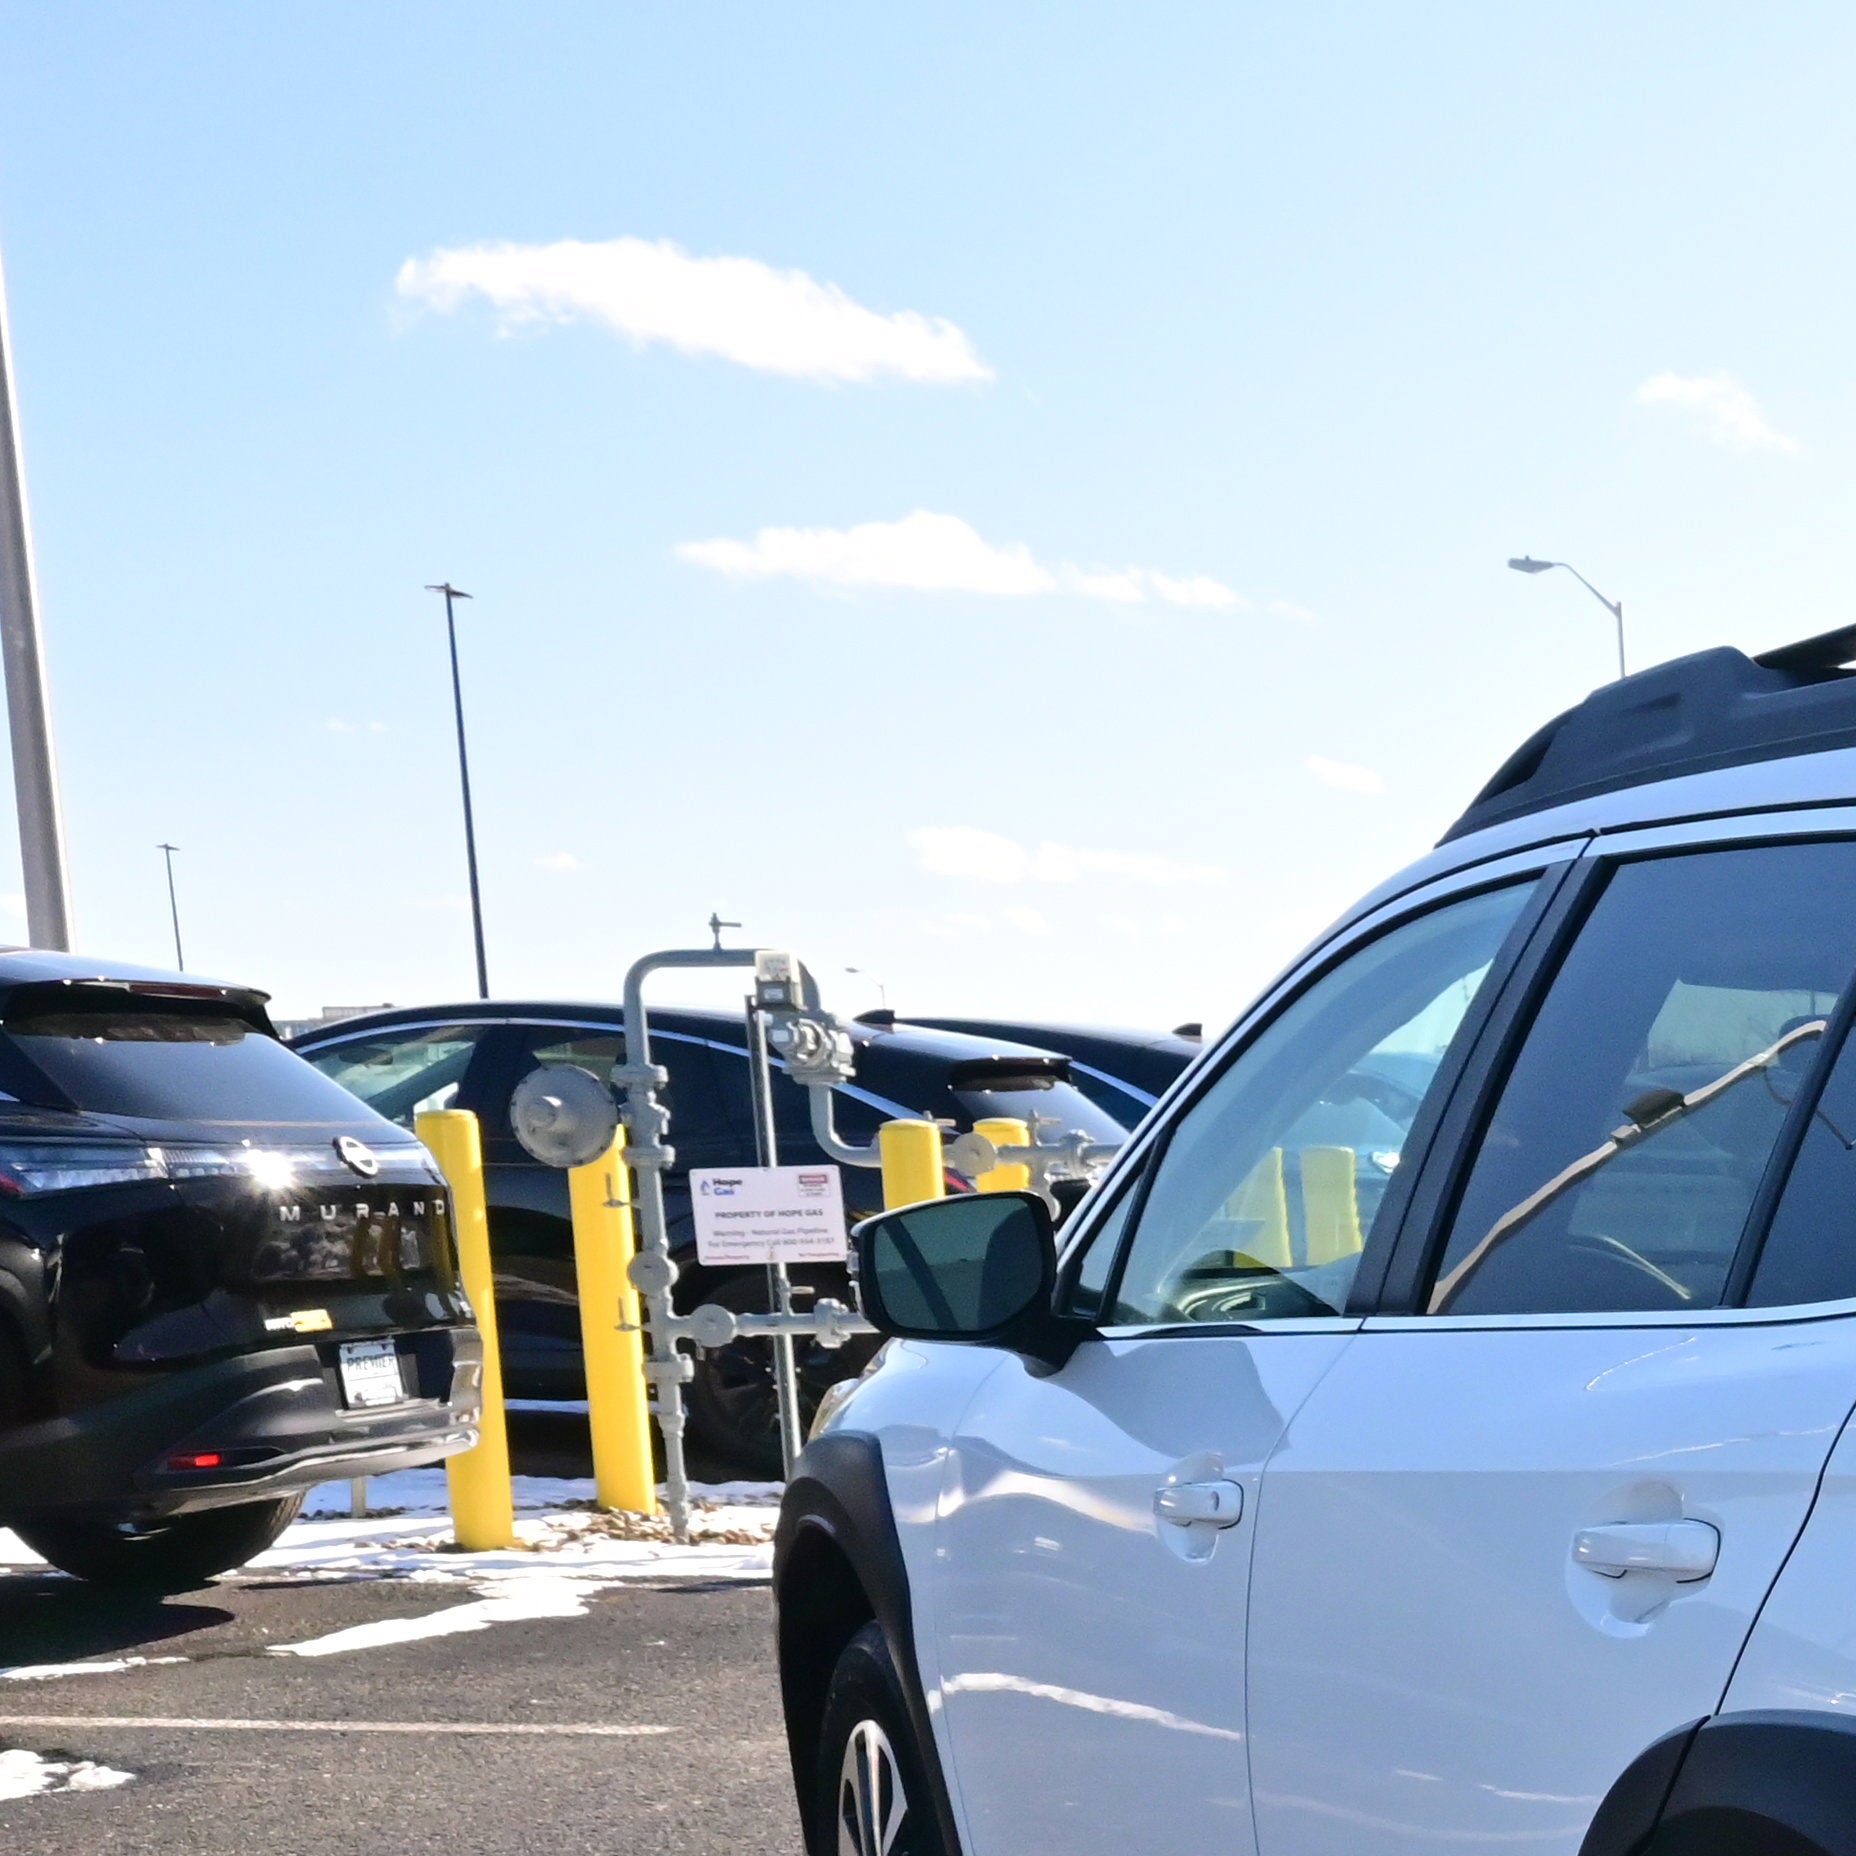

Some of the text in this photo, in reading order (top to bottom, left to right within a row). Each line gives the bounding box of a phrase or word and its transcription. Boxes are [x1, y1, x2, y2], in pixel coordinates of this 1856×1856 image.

[713, 1179, 742, 1187] Hope
[714, 1187, 735, 1196] Gas
[715, 1208, 823, 1219] PROPERTY OF HOPE GAS
